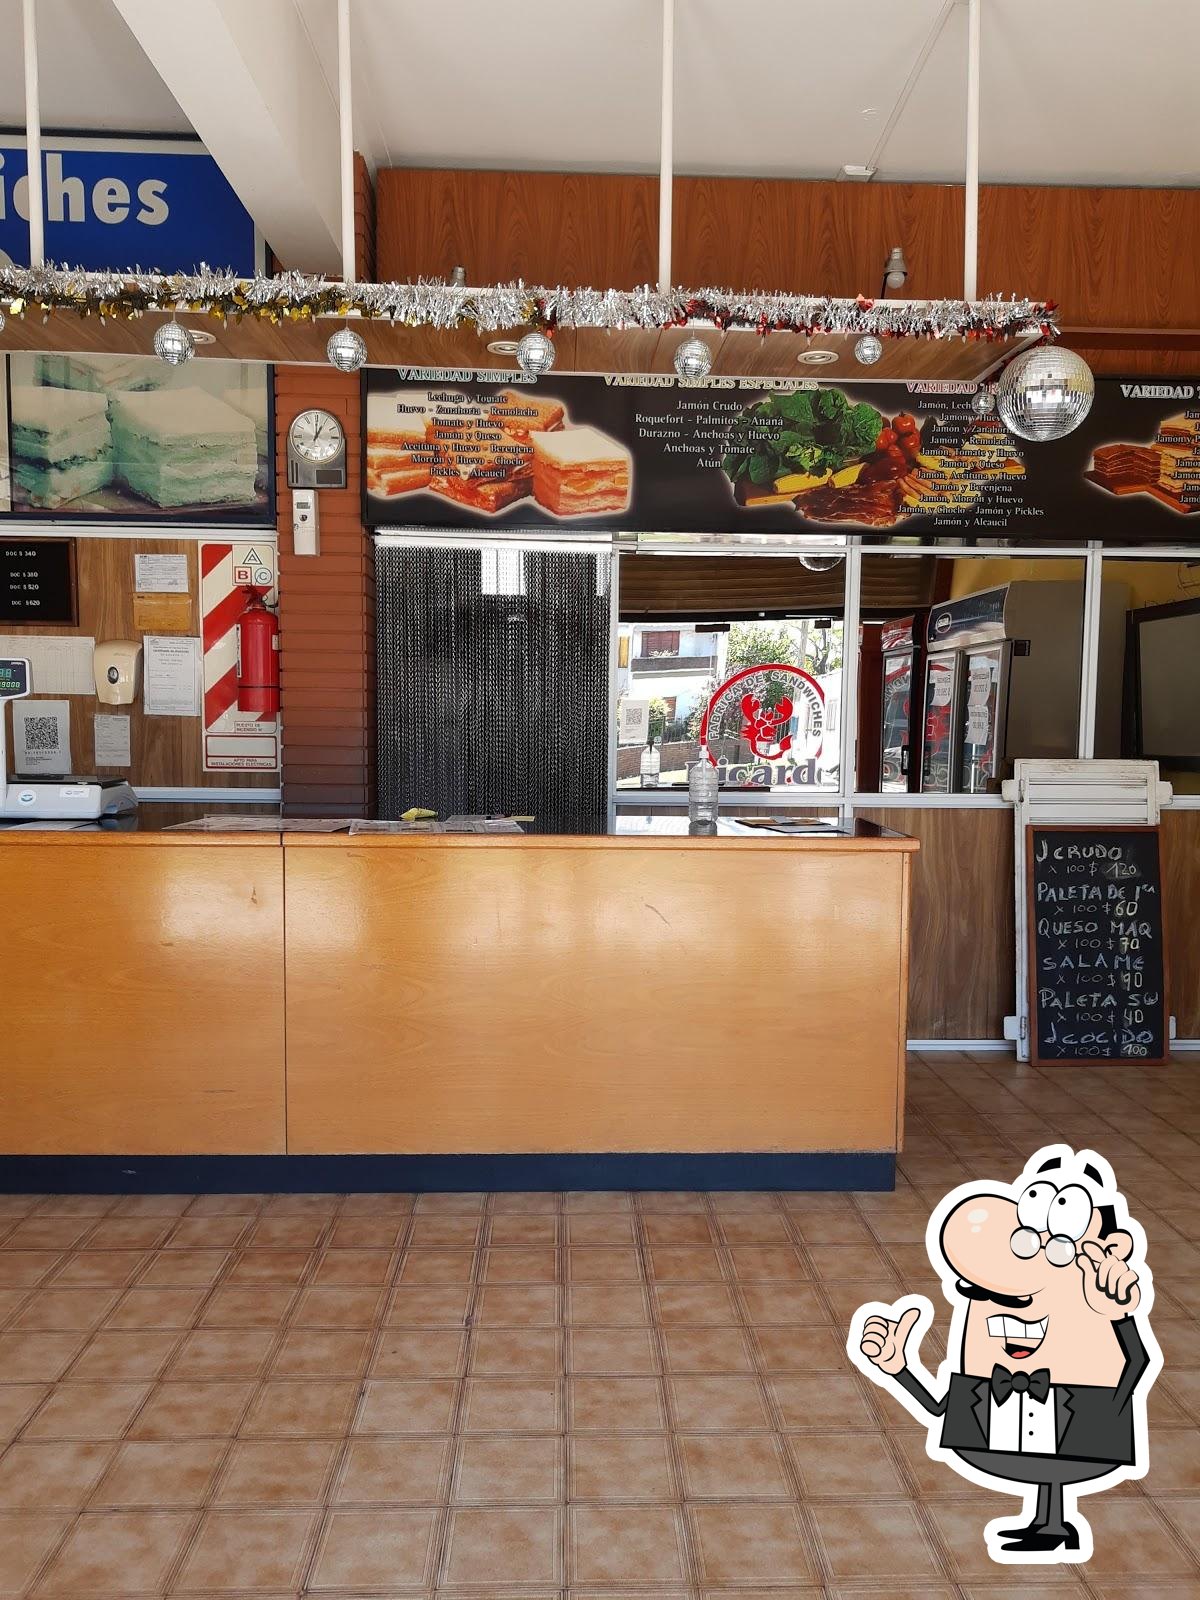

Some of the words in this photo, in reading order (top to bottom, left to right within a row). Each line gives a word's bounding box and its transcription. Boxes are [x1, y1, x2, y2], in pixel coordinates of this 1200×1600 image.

[397, 369, 473, 382] VARIEDAD
[477, 371, 537, 383] SIMPLES
[603, 375, 675, 387] VARIEDAD
[739, 379, 819, 390] ESPECIALES
[906, 382, 978, 394] VARIEDAD
[1120, 384, 1195, 399] VARIEDAD
[428, 392, 464, 402] Lechuga
[467, 396, 473, 404] y
[476, 394, 508, 403] Tomate
[397, 404, 426, 413] Huevo
[436, 407, 480, 415] Zanahoria
[491, 407, 538, 416] Remolacha
[676, 400, 710, 411] Jamón
[713, 401, 743, 411] Crudo
[918, 401, 948, 409] Jamón,
[952, 401, 972, 409] Lech
[635, 414, 684, 425] Roquefort
[696, 415, 739, 426] Palmitos
[751, 416, 783, 426] Ananá
[940, 413, 968, 421] Jamón
[432, 418, 464, 427] Tomate
[476, 419, 503, 428] Huevo
[932, 424, 959, 433] Jamón
[475, 432, 501, 441] Queso
[639, 428, 680, 438] Durazno
[693, 429, 735, 440] Anchoas
[738, 433, 744, 442] y
[748, 430, 780, 440] Huevo
[930, 436, 958, 444] Jamón
[969, 437, 1015, 445] Remolacha
[402, 442, 440, 451] Aceituna
[452, 443, 480, 452] Huevo
[490, 444, 534, 454] Berenjena
[664, 443, 706, 453] Anchoas
[708, 446, 714, 455] y
[719, 444, 755, 454] Tomate
[920, 448, 951, 457] Jamón,
[954, 448, 986, 457] Tomate
[997, 449, 1024, 457] Huevo
[412, 454, 444, 464] Morrón
[456, 456, 484, 465] Huevo
[495, 457, 524, 465] Choclo
[696, 457, 721, 468] Atún
[939, 460, 968, 468] Jamón
[980, 461, 1005, 469] Queso
[430, 467, 460, 476] Pickles
[471, 468, 506, 478] Alcaucil
[916, 471, 947, 480] Jamón,
[951, 472, 988, 480] Aceituna
[1000, 472, 1027, 480] Huevo
[931, 483, 960, 491] Jamón
[970, 483, 1012, 493] Berenjena
[919, 494, 949, 503] Jamón,
[952, 494, 984, 503] Morrón
[996, 495, 1023, 503] Huevo
[897, 505, 925, 514] Jamón
[937, 506, 966, 514] Choclo
[975, 506, 1004, 515] Jamón
[1015, 507, 1044, 515] Pickles
[934, 517, 962, 526] Jamón
[973, 518, 1007, 526] Alcaucil
[248, 553, 256, 561] A
[238, 571, 248, 579] B
[259, 572, 267, 581] C
[709, 684, 745, 740] FABRICA
[745, 674, 764, 687] DE
[771, 671, 822, 737] SANDWICHES
[1066, 863, 1085, 873] 100
[1106, 862, 1137, 875] 120
[1037, 882, 1102, 902] PALETA
[1108, 884, 1126, 900] DE
[1073, 904, 1097, 913] 100
[1115, 901, 1138, 916] 60
[1038, 919, 1098, 937] QUESO
[1110, 920, 1153, 938] MAQ
[1075, 938, 1101, 948] 100
[1042, 954, 1144, 971] SALAME
[1076, 973, 1103, 983] 100
[1122, 972, 1143, 991] 90
[1039, 987, 1117, 1008] PALETA
[1076, 1012, 1102, 1022] 100
[1124, 1008, 1144, 1026] 40
